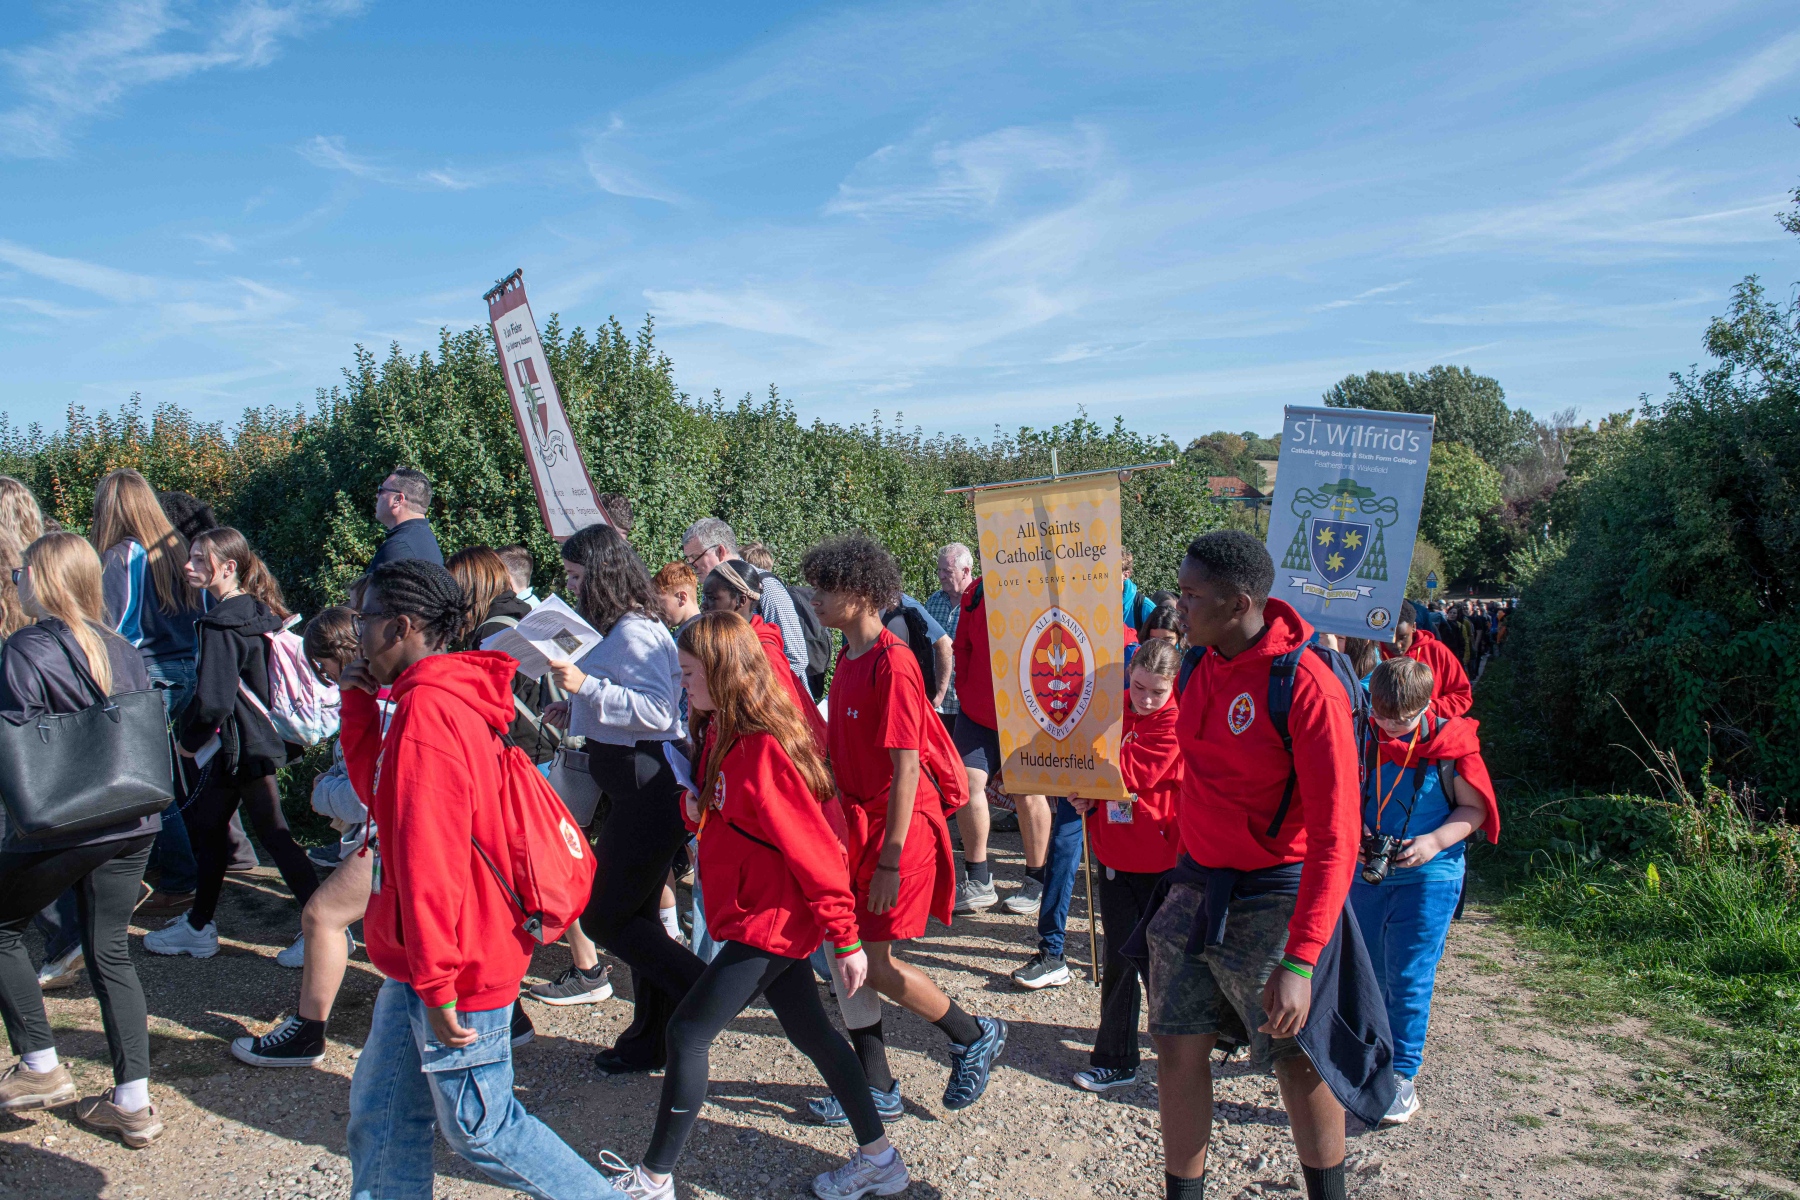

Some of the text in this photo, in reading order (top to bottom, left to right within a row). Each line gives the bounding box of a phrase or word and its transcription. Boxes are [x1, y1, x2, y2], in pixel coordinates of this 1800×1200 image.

[1326, 423, 1420, 453] Wilfrid's
[1291, 447, 1315, 455] Catholic
[1315, 449, 1330, 458] High
[1358, 453, 1375, 461] Sixth
[1375, 454, 1392, 462] Form
[1393, 456, 1417, 466] College
[1357, 464, 1389, 474] Wakefield
[1016, 520, 1081, 539] All Saints
[995, 541, 1107, 565] Catholic College
[998, 572, 1109, 587] LOVE SERVE LEARN
[1304, 585, 1326, 596] FIDEM
[1035, 614, 1087, 644] ALL SAINTS
[1023, 680, 1093, 737] LOVE SERVE LEARN
[1020, 751, 1095, 771] Huddersfield
